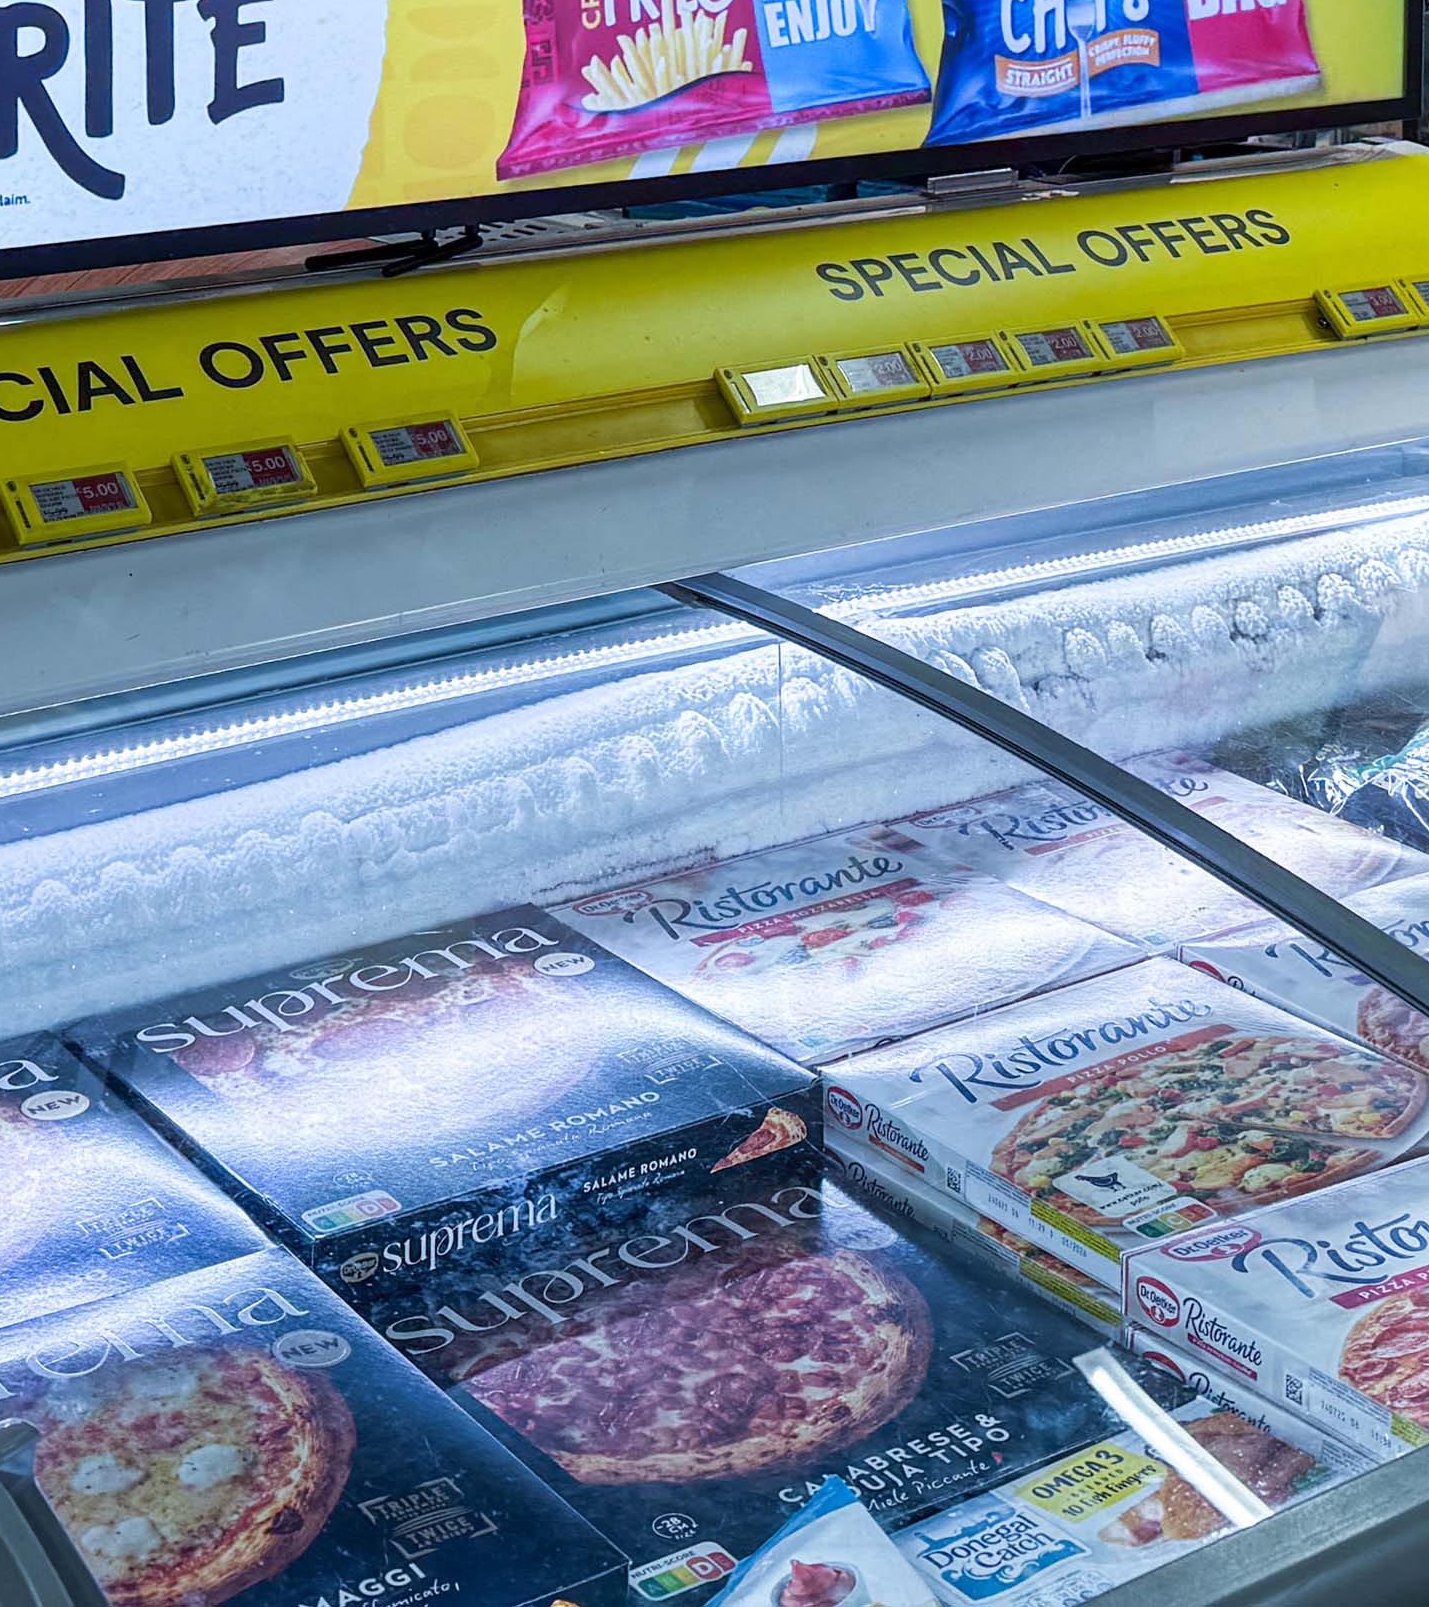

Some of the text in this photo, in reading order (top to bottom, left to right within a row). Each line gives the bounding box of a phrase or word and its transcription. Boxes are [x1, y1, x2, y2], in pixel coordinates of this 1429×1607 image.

[1005, 65, 1074, 86] STRAIGHT
[1096, 47, 1150, 66] PERFECTION
[814, 209, 1292, 303] SPECIAL OFFERS
[200, 307, 498, 390] OFFERS
[625, 852, 903, 941] Ristorante
[540, 955, 588, 975] NEW
[136, 922, 558, 1055] suprema
[909, 993, 1212, 1106] Ristorante
[1067, 1045, 1167, 1085] PIZZA POLLO
[30, 1096, 82, 1115] NEW
[430, 1090, 662, 1171] SALAME ROMANO
[864, 1103, 930, 1163] Ristorante
[582, 1147, 698, 1194] SALAME ROMANO
[382, 1193, 558, 1277] suprema
[386, 1182, 826, 1355] suprema
[1358, 1274, 1415, 1301] PIZZA
[281, 1335, 342, 1363] NEW
[1183, 1297, 1264, 1367] Ristorante
[966, 1339, 1023, 1369] TRIPLE
[1004, 1360, 1054, 1388] TWICE
[778, 1420, 972, 1505] CAABRESE
[975, 1413, 1001, 1429] &
[928, 1427, 1011, 1465] TIPO
[914, 1460, 990, 1499] Piccante
[1032, 1449, 1124, 1500] OMEGA 3
[1062, 1503, 1082, 1517] 10
[1108, 1463, 1157, 1496] Fingers
[373, 1482, 449, 1519] TRIPLE
[405, 1515, 472, 1545] TWICE
[922, 1512, 1038, 1571] Donegal
[976, 1531, 1056, 1571] Catch
[631, 1548, 698, 1580] NUTRI-SCORE
